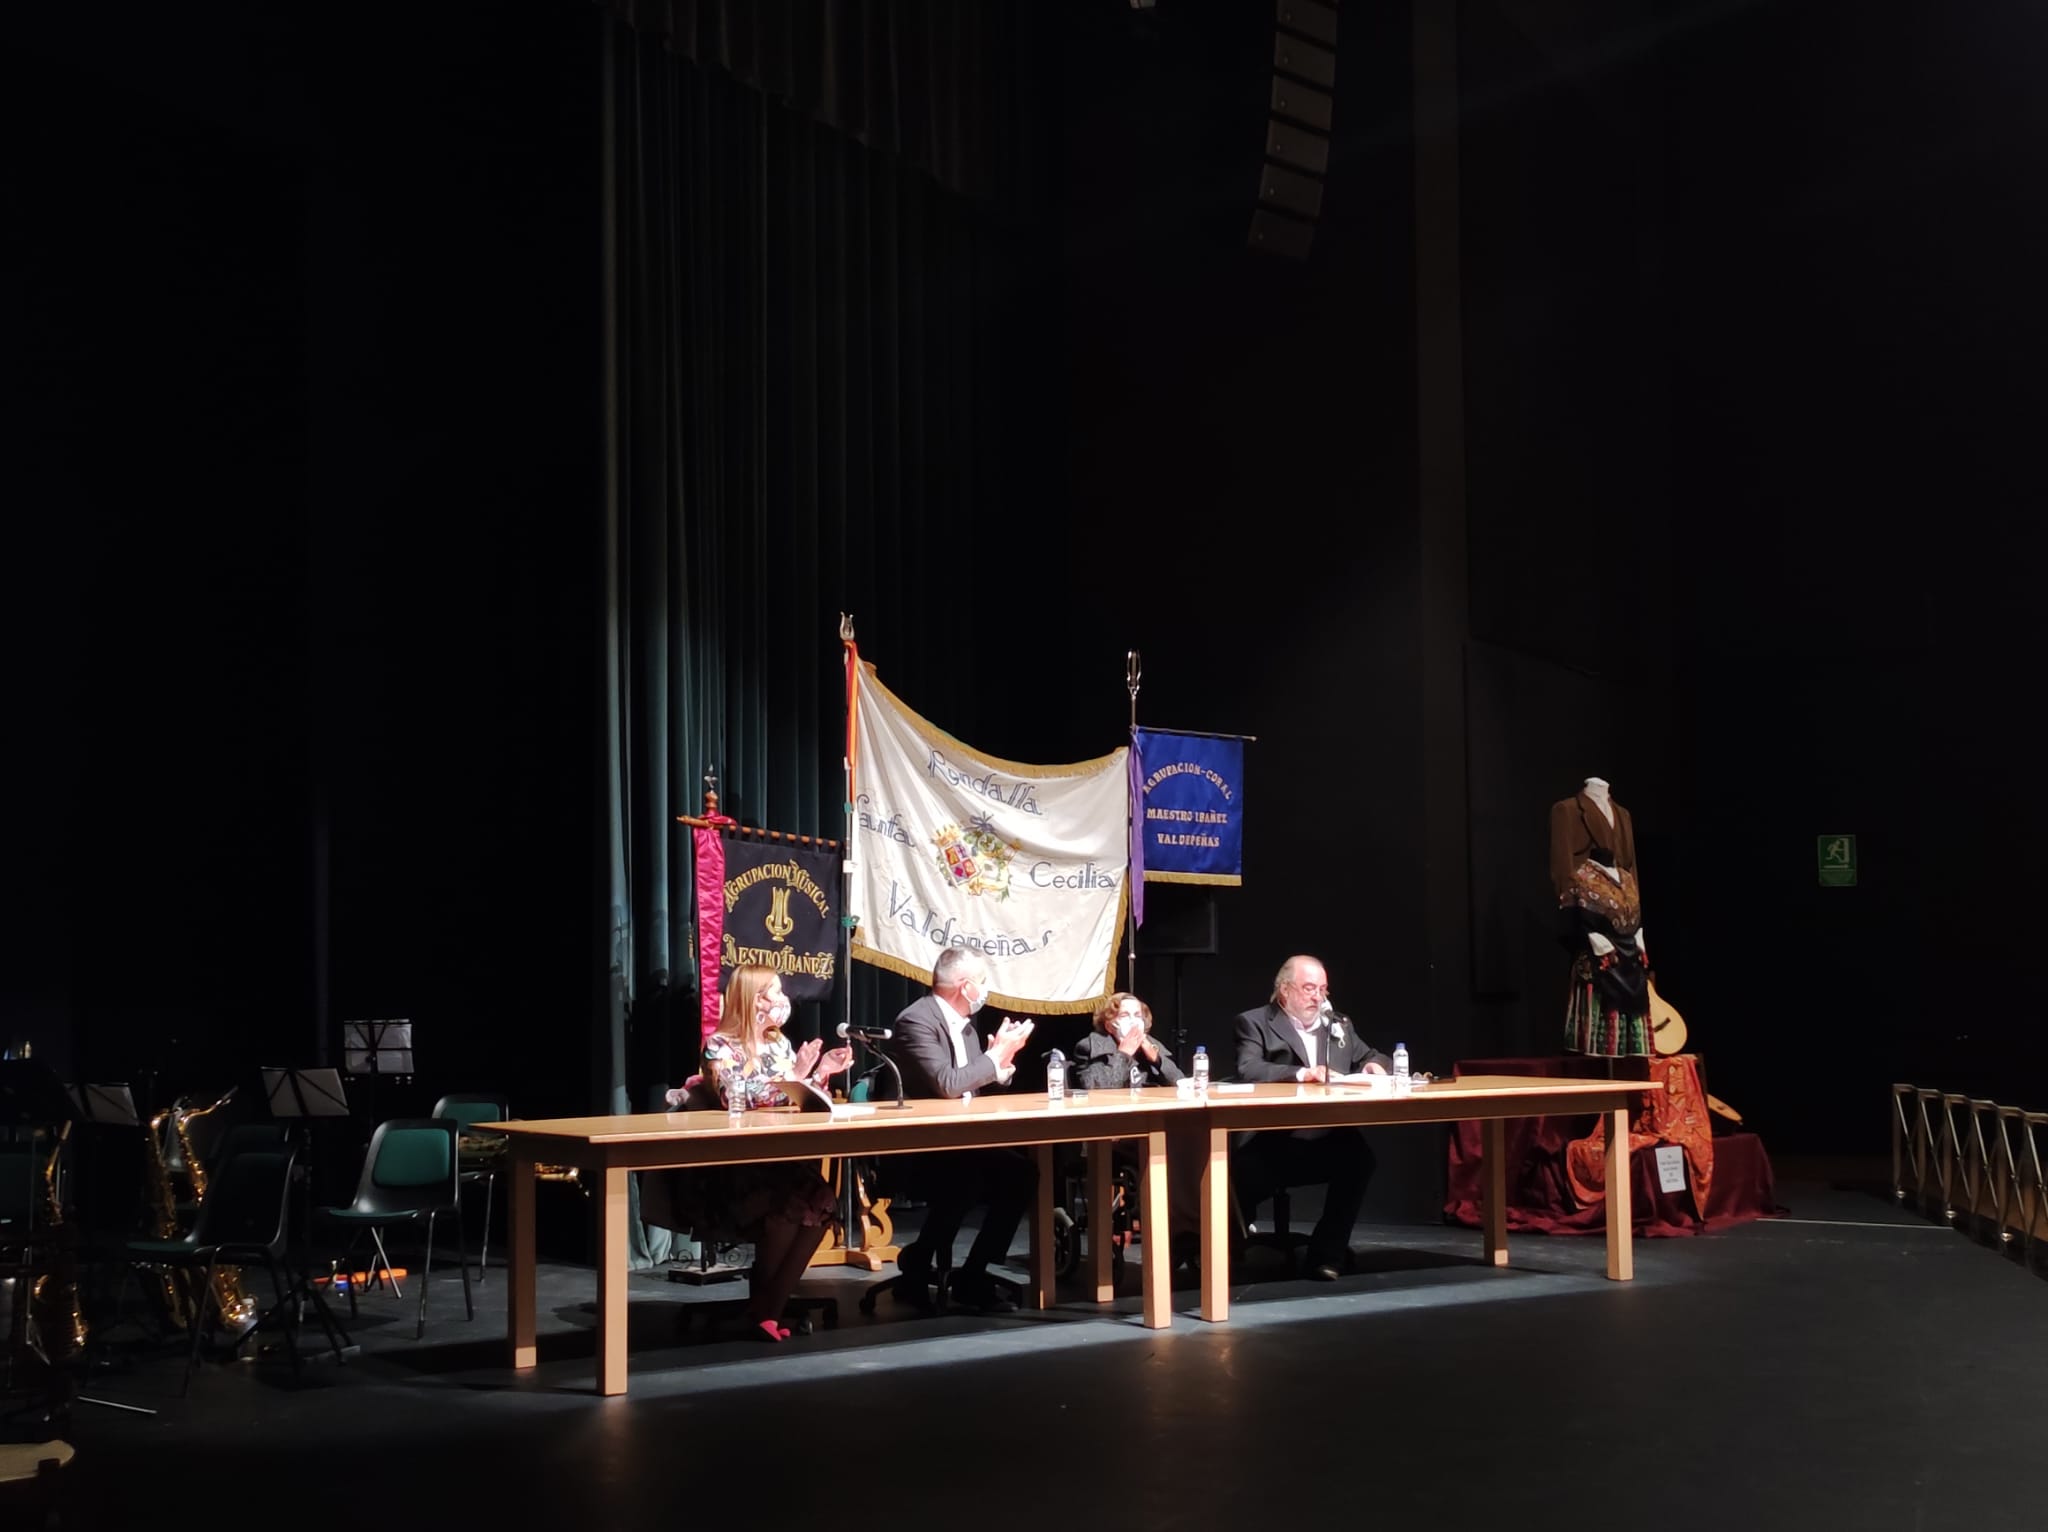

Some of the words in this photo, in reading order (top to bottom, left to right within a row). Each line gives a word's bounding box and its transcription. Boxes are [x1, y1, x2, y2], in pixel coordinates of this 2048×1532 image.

[928, 750, 1042, 815] Rondalla
[1147, 808, 1192, 822] MAESTRO
[1195, 809, 1228, 824] IBAÑEZ
[1157, 833, 1220, 847] VALDEPEÑAS
[723, 864, 791, 912] AGRUPACION
[786, 859, 830, 918] MUSICAL
[1030, 861, 1115, 889] Cecilia
